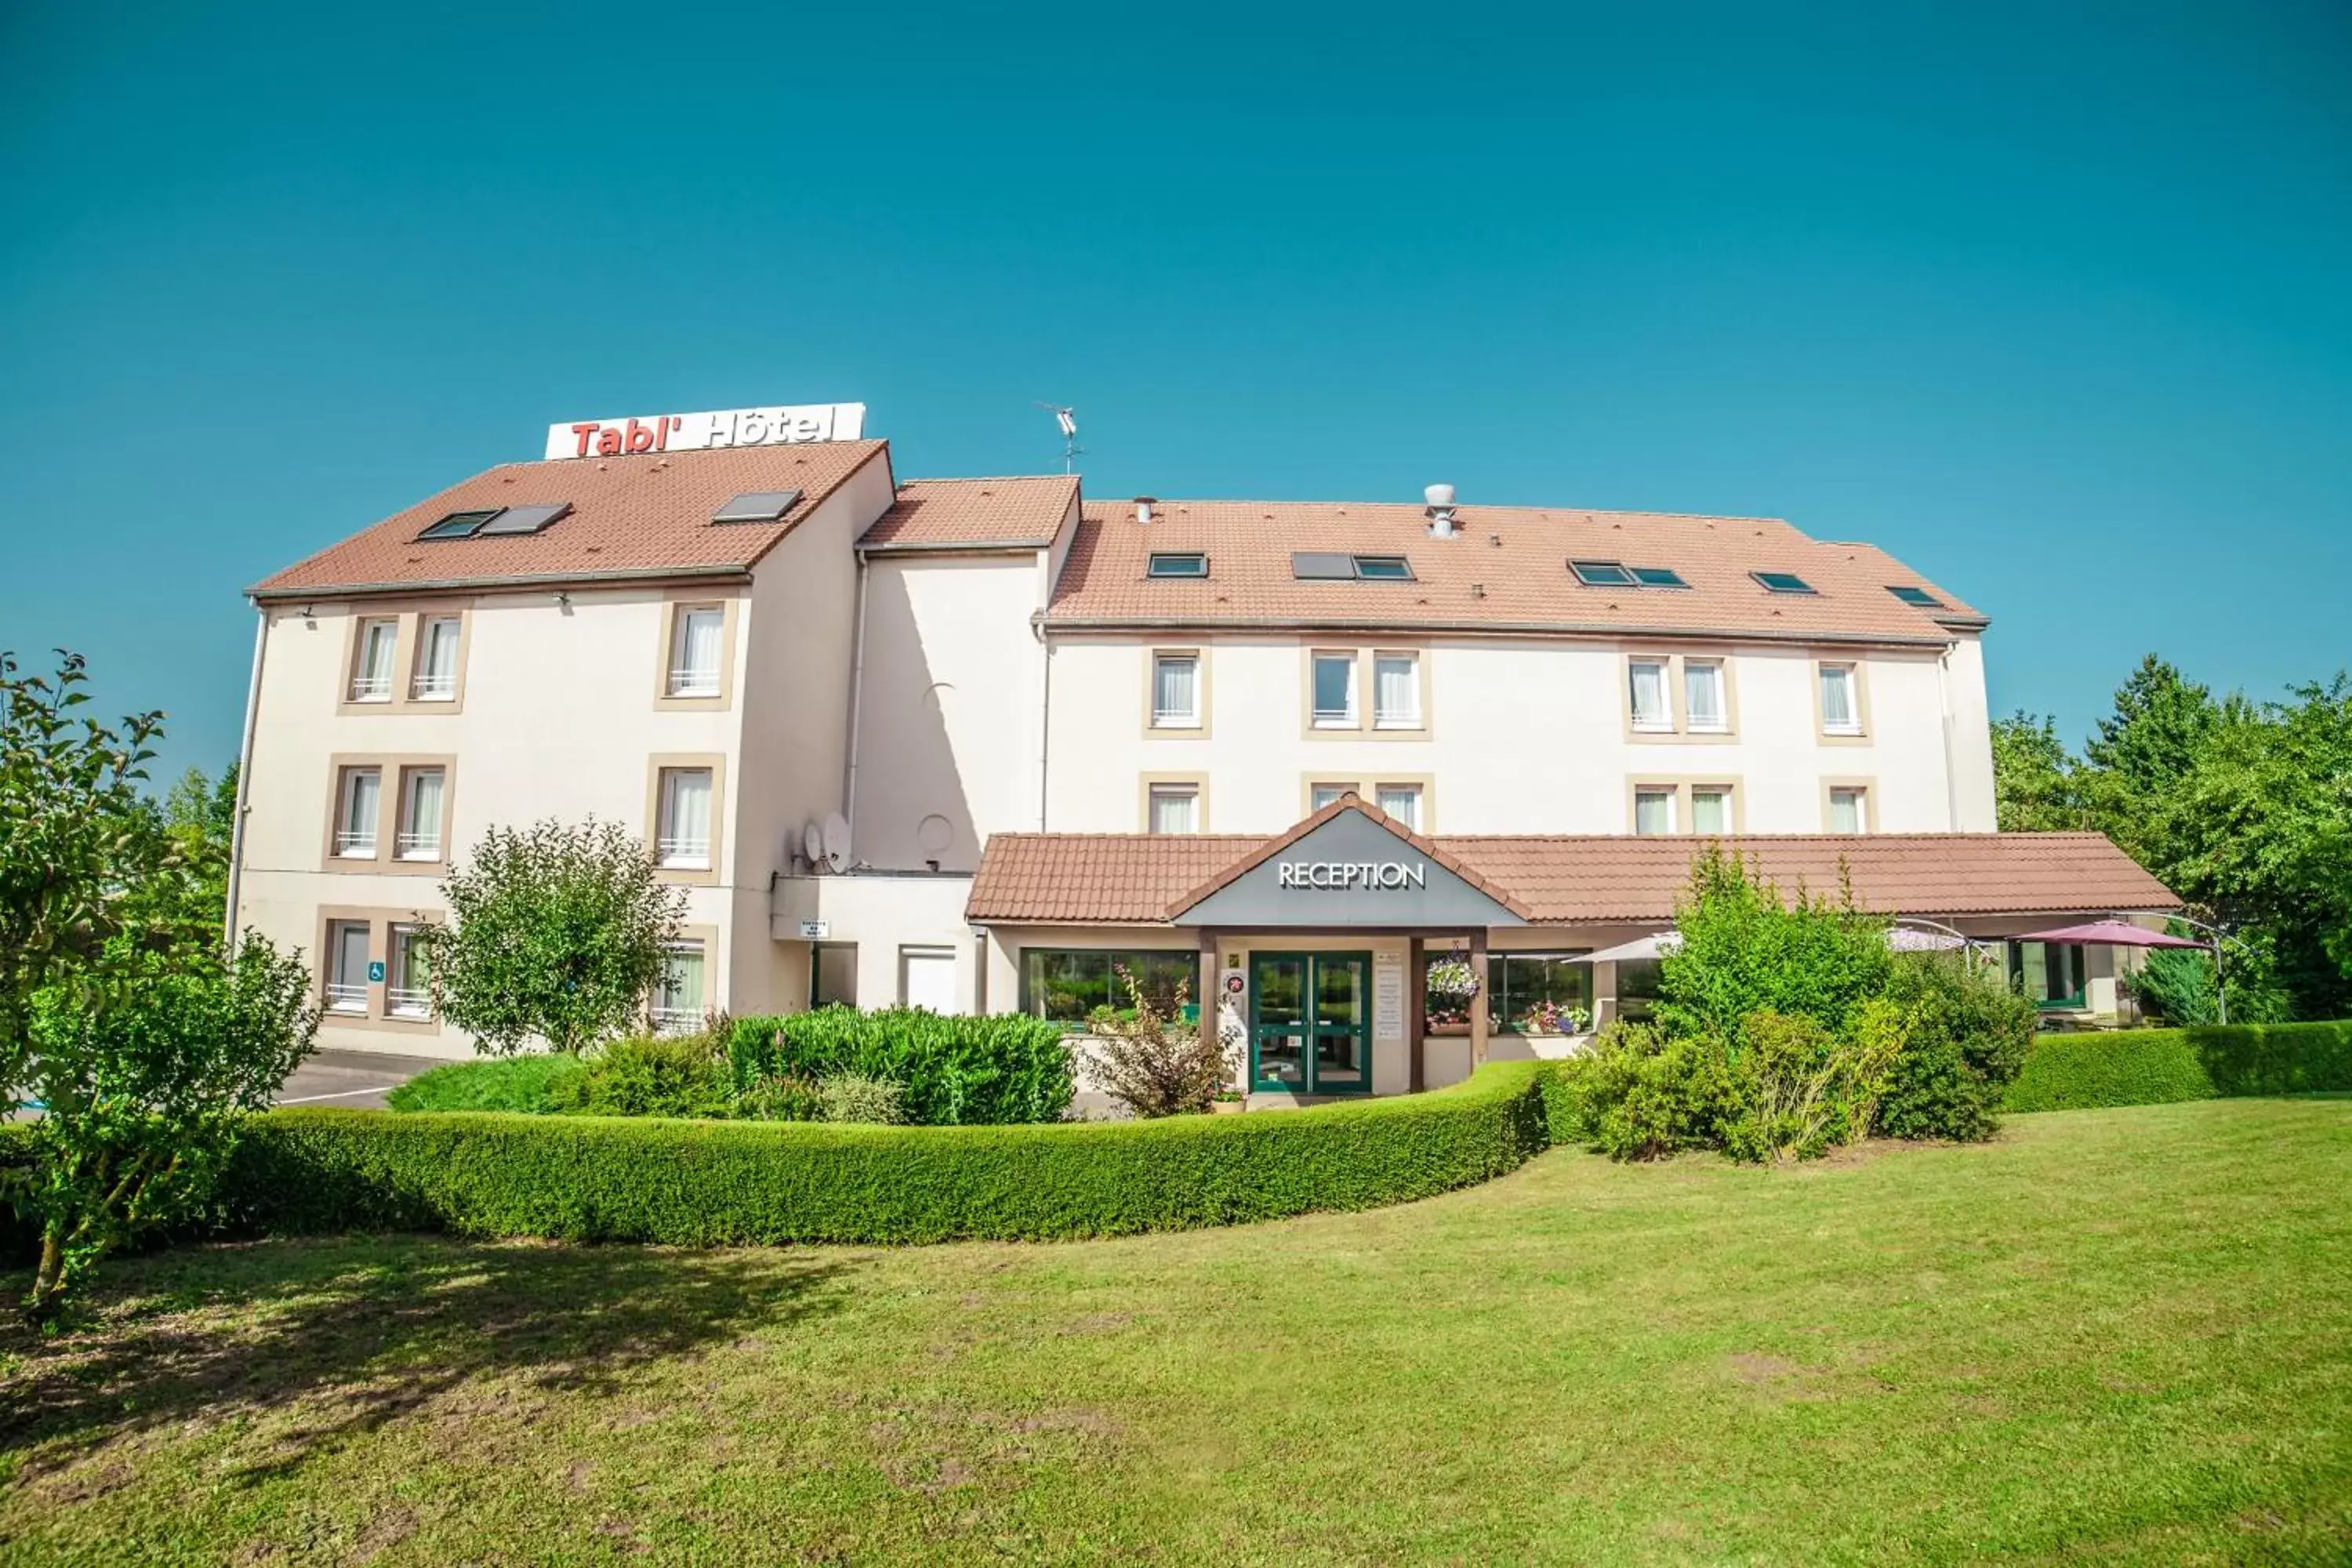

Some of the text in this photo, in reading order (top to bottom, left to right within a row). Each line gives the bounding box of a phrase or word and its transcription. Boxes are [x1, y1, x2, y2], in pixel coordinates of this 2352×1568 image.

[572, 407, 836, 456] Tabl' Hôtel
[1279, 862, 1426, 889] RECEPTION
